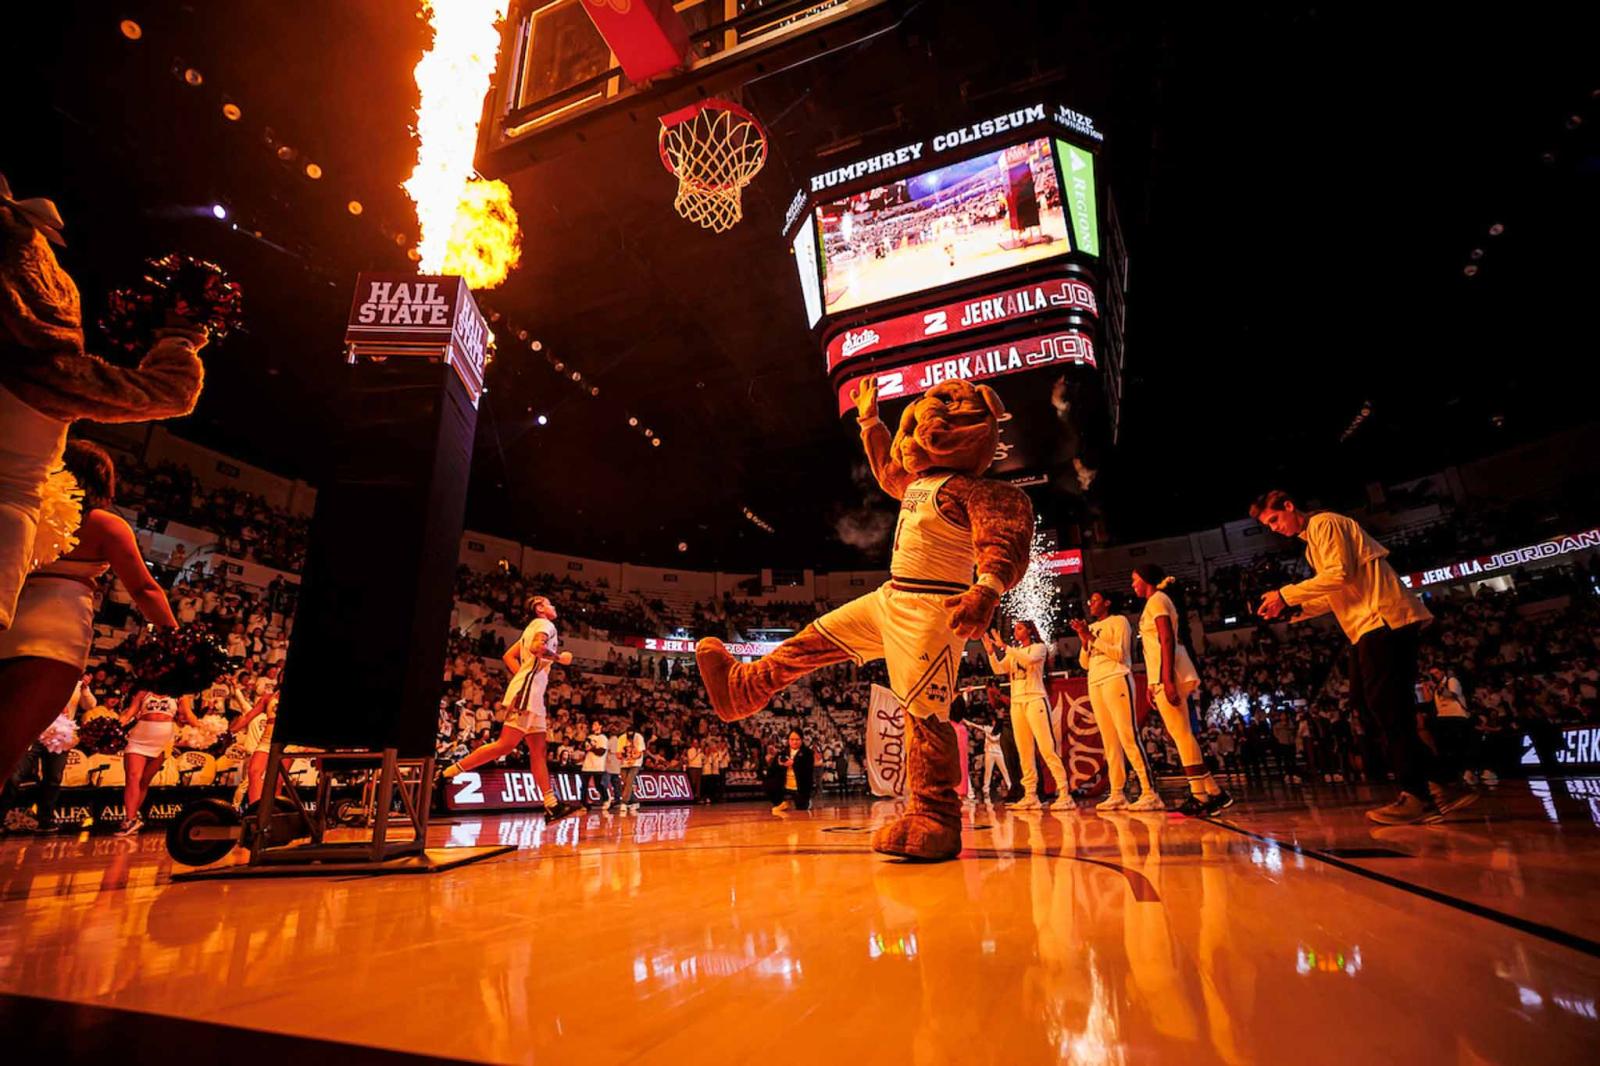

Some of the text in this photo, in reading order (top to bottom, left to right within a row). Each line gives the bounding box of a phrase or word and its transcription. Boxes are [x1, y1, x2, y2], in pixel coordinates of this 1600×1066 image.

[1059, 105, 1094, 129] MIZE
[810, 103, 1046, 192] HUMPHREY COLISEUM
[1073, 176, 1092, 254] REGIONS
[368, 282, 444, 304] HAIL
[359, 304, 449, 325] STATE
[924, 311, 948, 335] 2
[961, 287, 1047, 326] JERKAILA
[842, 329, 879, 357] State
[877, 373, 904, 397] 2
[920, 346, 1022, 388] JERKAILA
[1421, 560, 1482, 585] JERKAILA
[1483, 529, 1600, 571] JORDAN
[645, 638, 656, 649] 2
[452, 772, 485, 804] 2
